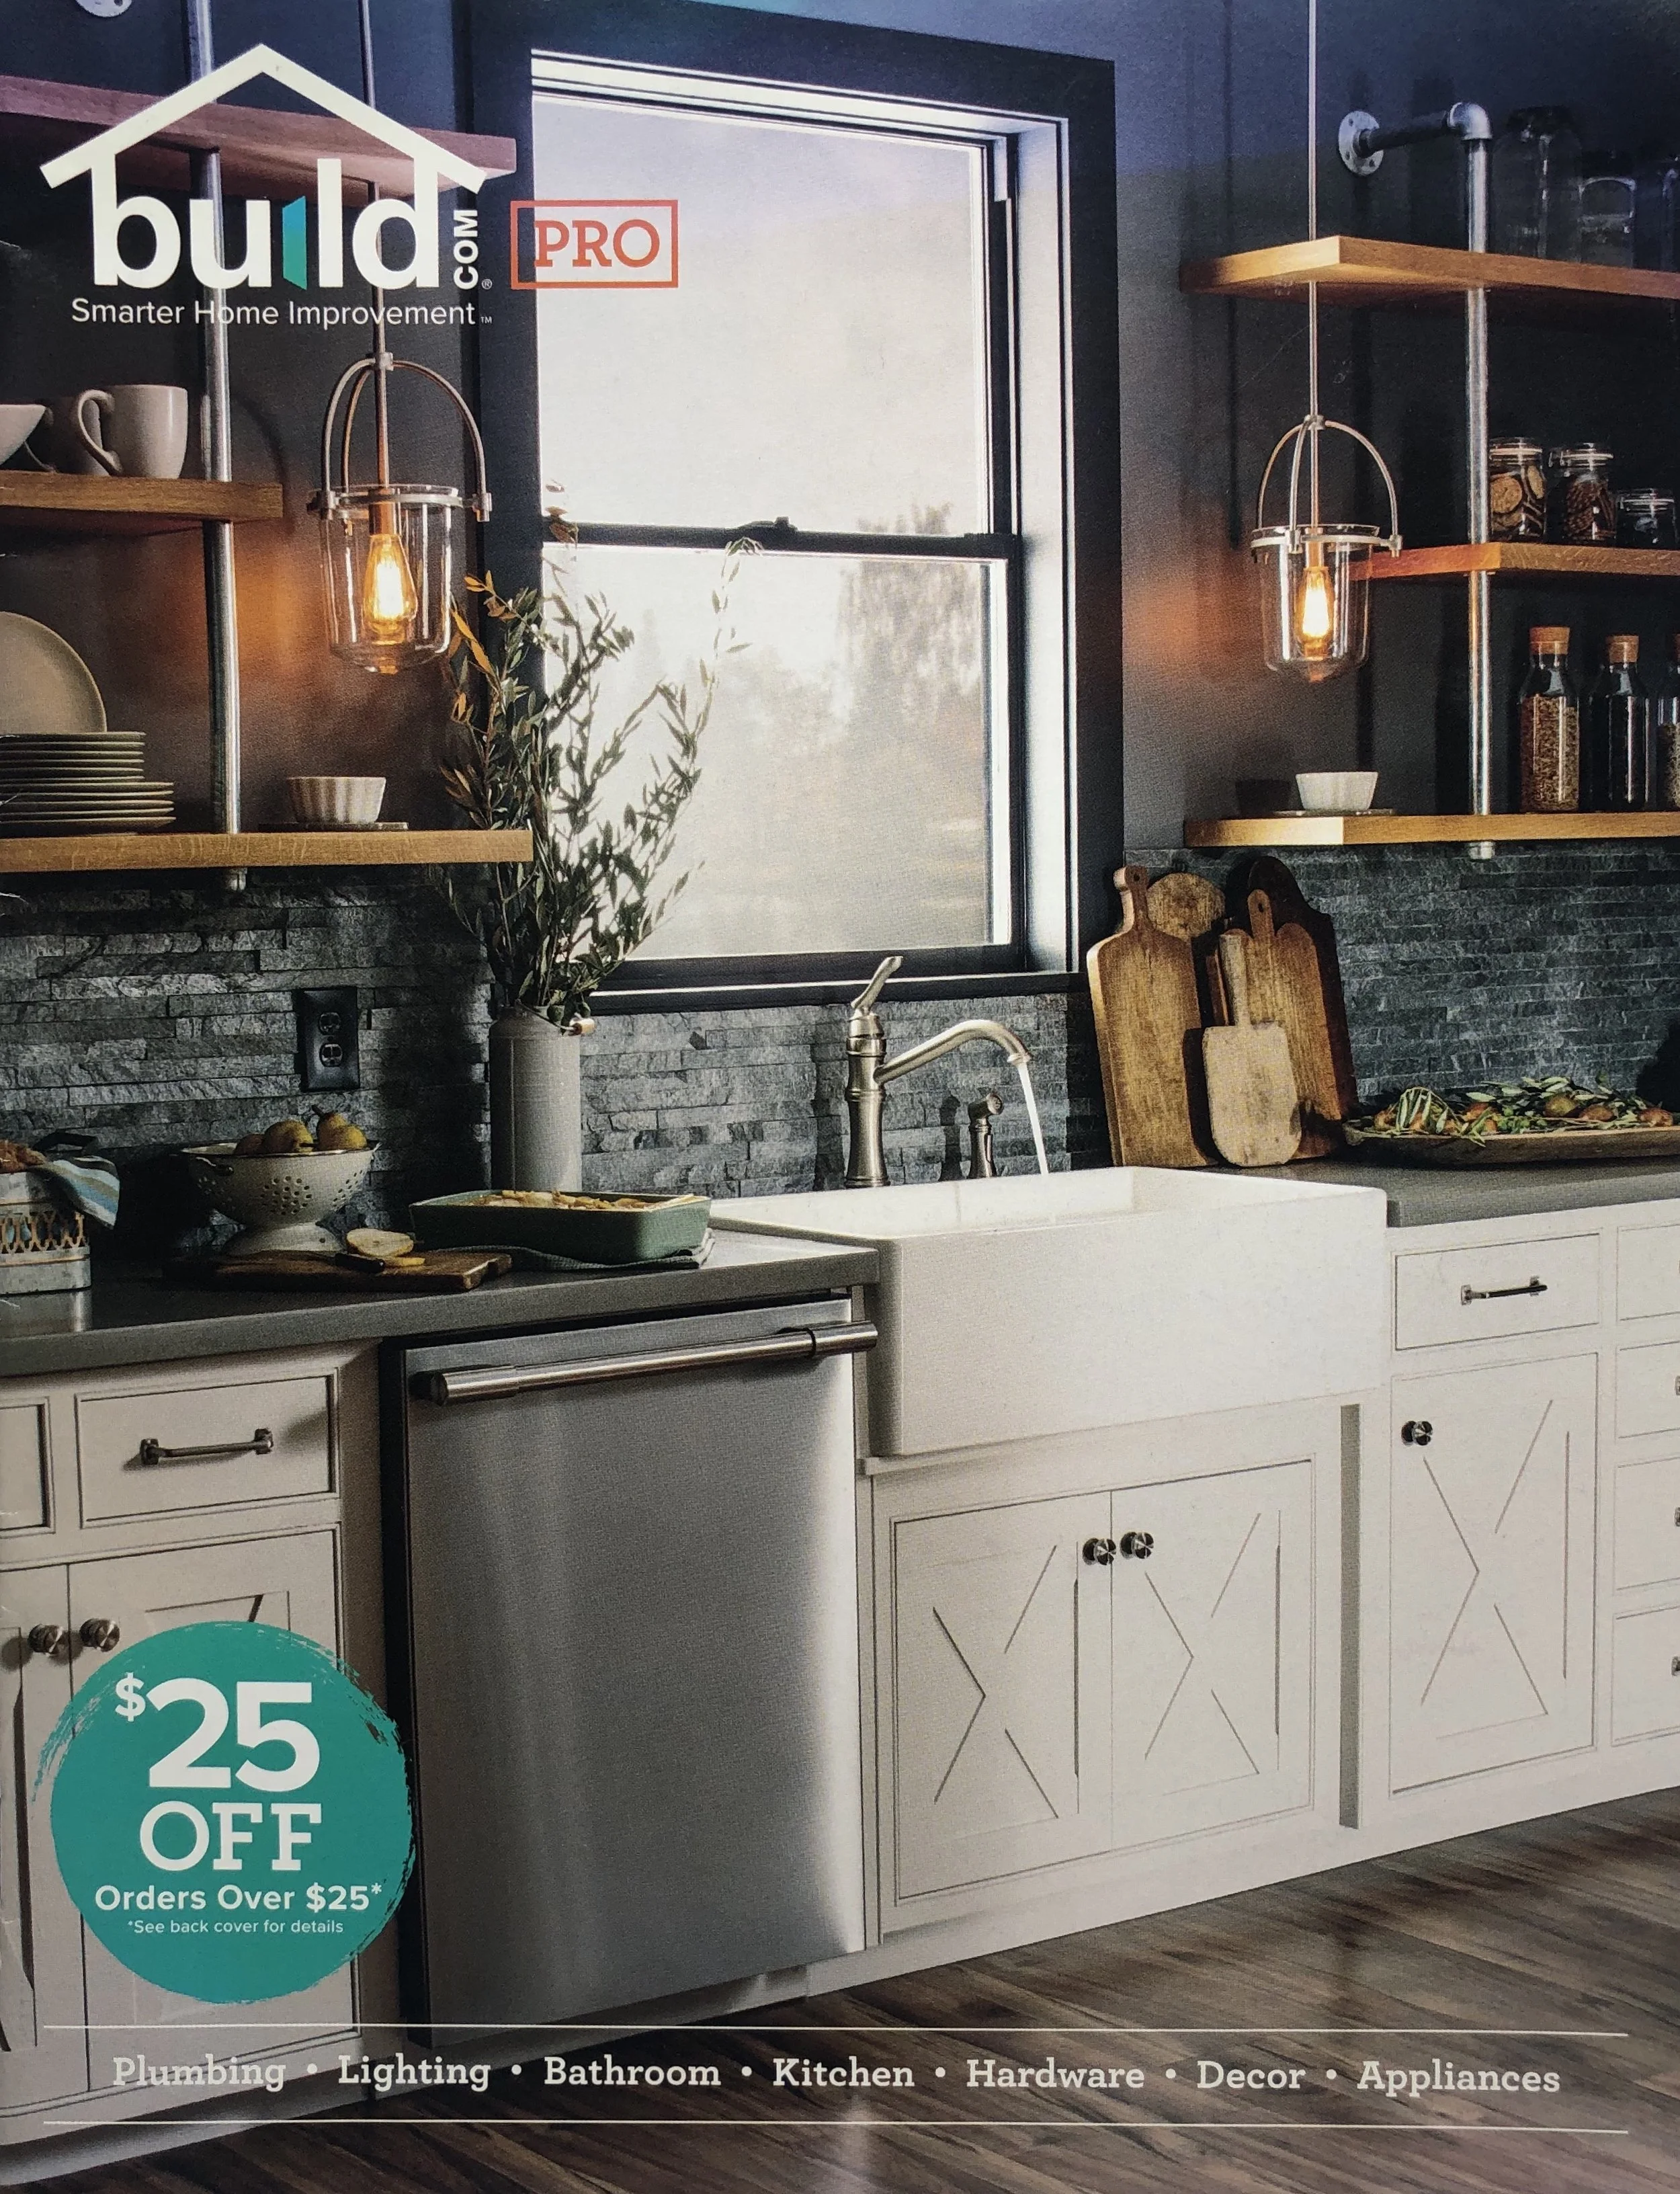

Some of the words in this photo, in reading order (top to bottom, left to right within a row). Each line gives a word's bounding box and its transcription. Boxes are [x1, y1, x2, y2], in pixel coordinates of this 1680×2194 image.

[453, 209, 478, 290] COM
[535, 219, 660, 268] PRO
[71, 298, 185, 324] Smarter
[194, 300, 279, 324] Home
[289, 300, 476, 330] Improvement
[115, 1672, 320, 1792] $25
[140, 1801, 322, 1871] OFF
[95, 1884, 206, 1911] Orders
[217, 1884, 295, 1910] Over
[169, 1919, 208, 1934] back
[214, 1922, 258, 1934] cover
[263, 1919, 286, 1933] for
[291, 1919, 344, 1934] details
[112, 2054, 286, 2093] Plumbing
[337, 2055, 491, 2093] Lighting
[543, 2054, 722, 2086] Bathroom
[772, 2056, 915, 2088] Kitchen
[965, 2056, 1146, 2089] Hardware
[1197, 2060, 1306, 2090] Decor
[1356, 2058, 1562, 2097] Appliances
